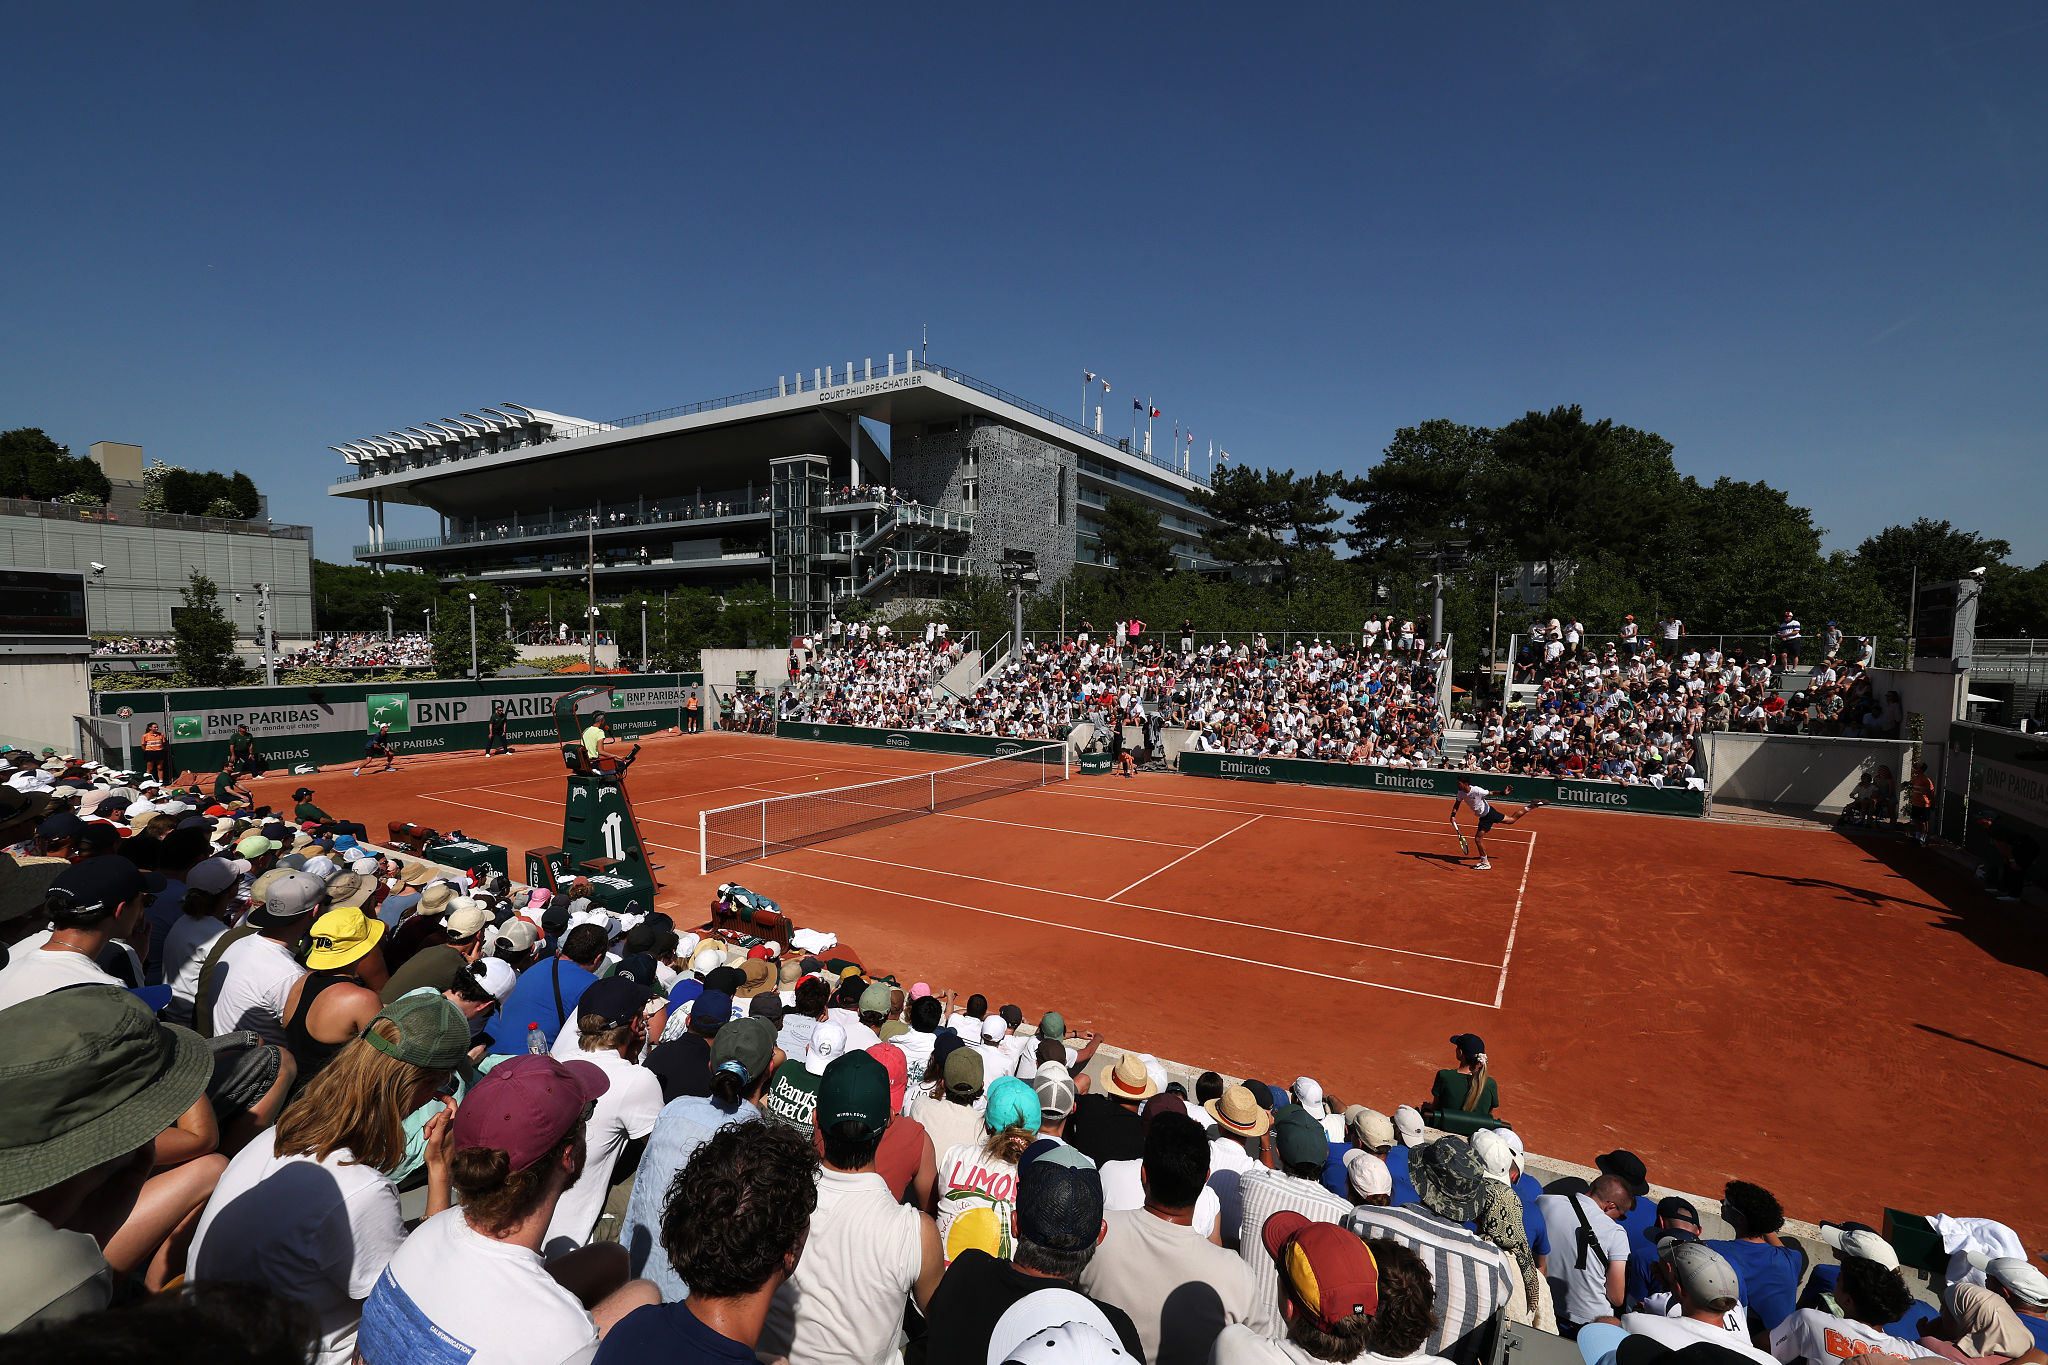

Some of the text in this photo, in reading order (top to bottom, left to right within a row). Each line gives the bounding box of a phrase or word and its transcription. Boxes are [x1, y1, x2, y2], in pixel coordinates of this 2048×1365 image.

[820, 376, 922, 401] COURT PHILIPPE-CHATRIER
[627, 690, 686, 702] BNP PARIBAS
[417, 701, 467, 723] BNP
[491, 697, 578, 717] PARIB
[207, 709, 319, 728] BNP PARIBAS
[612, 720, 657, 731] BNP PARIBAS
[218, 728, 239, 736] banqu
[286, 723, 296, 731] qui
[506, 728, 559, 740] BNP PARIBAS
[403, 737, 445, 749] PARIBAS
[1100, 760, 1111, 769] Haier
[1220, 760, 1271, 776] Emirates
[1375, 772, 1435, 789] Emirates
[1986, 767, 2007, 789] BNP
[1557, 786, 1628, 805] Emirates
[775, 1075, 817, 1109] Peanuts
[430, 1325, 472, 1355] CALIFORNICATION
